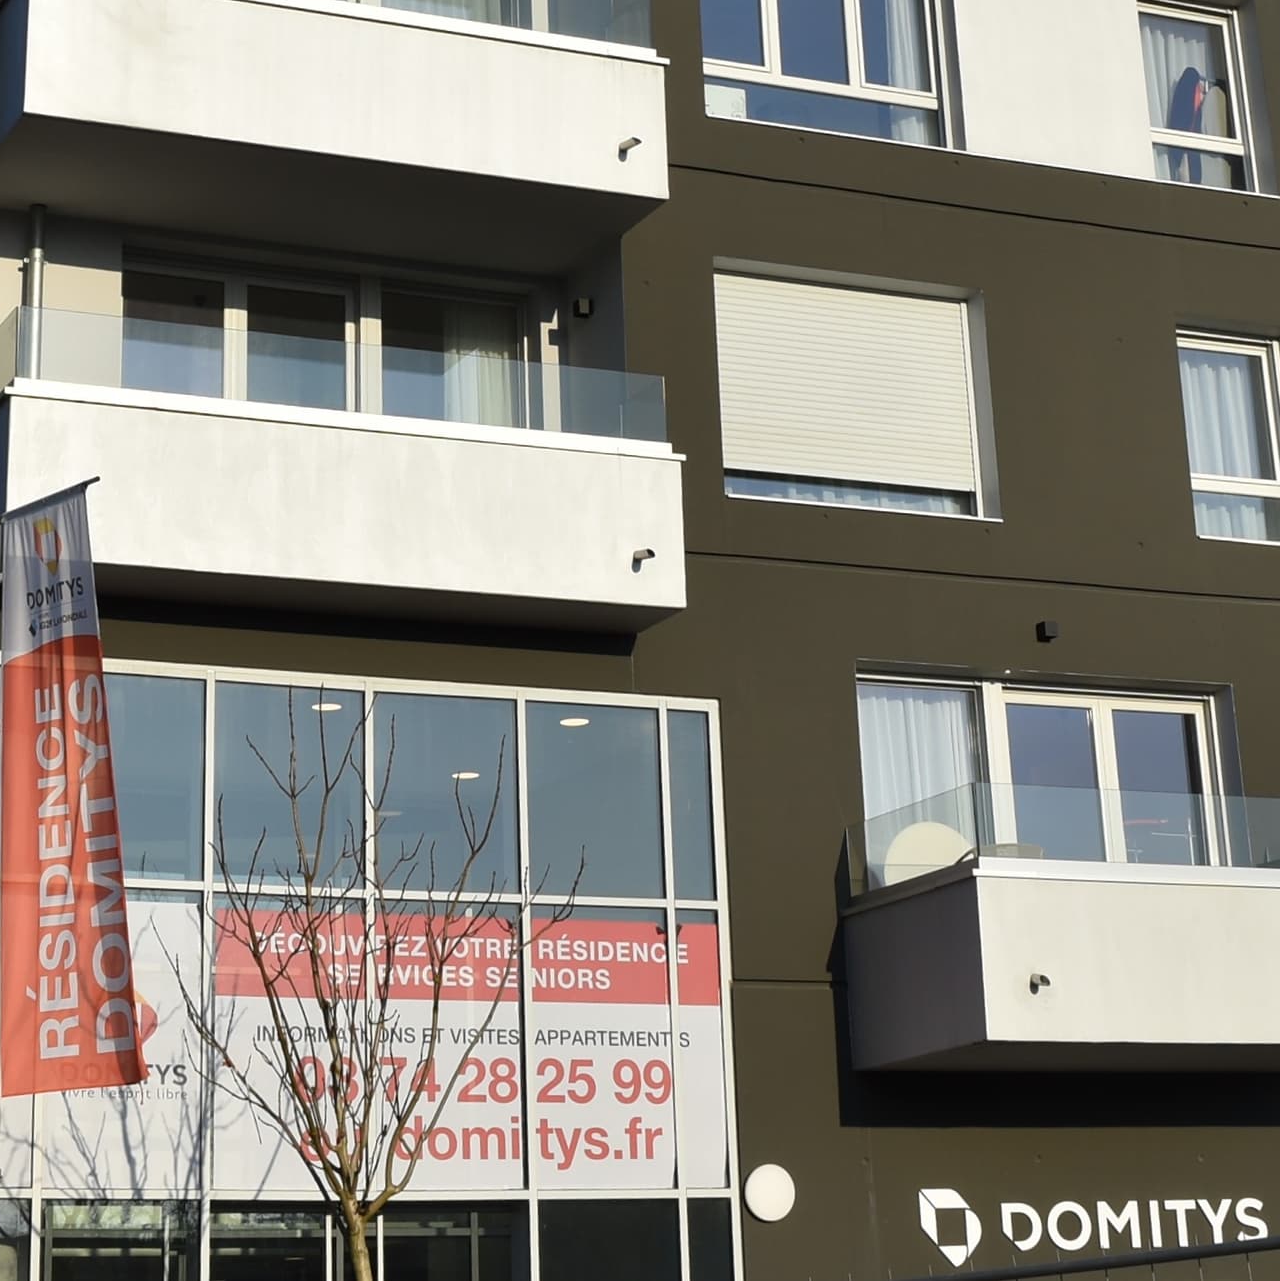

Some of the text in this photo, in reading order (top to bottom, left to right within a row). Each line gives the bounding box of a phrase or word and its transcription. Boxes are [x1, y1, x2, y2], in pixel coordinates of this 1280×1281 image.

[26, 577, 84, 609] DOMITYS
[26, 684, 79, 1060] RÉSIDENCE
[68, 673, 136, 1054] DOMITYS
[435, 935, 518, 960] VOTRE
[538, 934, 689, 964] RÉSIDENCE
[328, 964, 611, 991] SERVICES SENIORS
[256, 1025, 690, 1048] INORMATIONS ET VISITES APPARTEMENTS
[61, 1085, 188, 1101] ivre l'esprt libre
[379, 1056, 441, 1103] 74
[457, 1056, 519, 1104] 28
[536, 1057, 597, 1104] 25
[612, 1058, 671, 1105] 99
[393, 1116, 663, 1171] domitys.fr
[1000, 1198, 1269, 1252] DOMITYS
